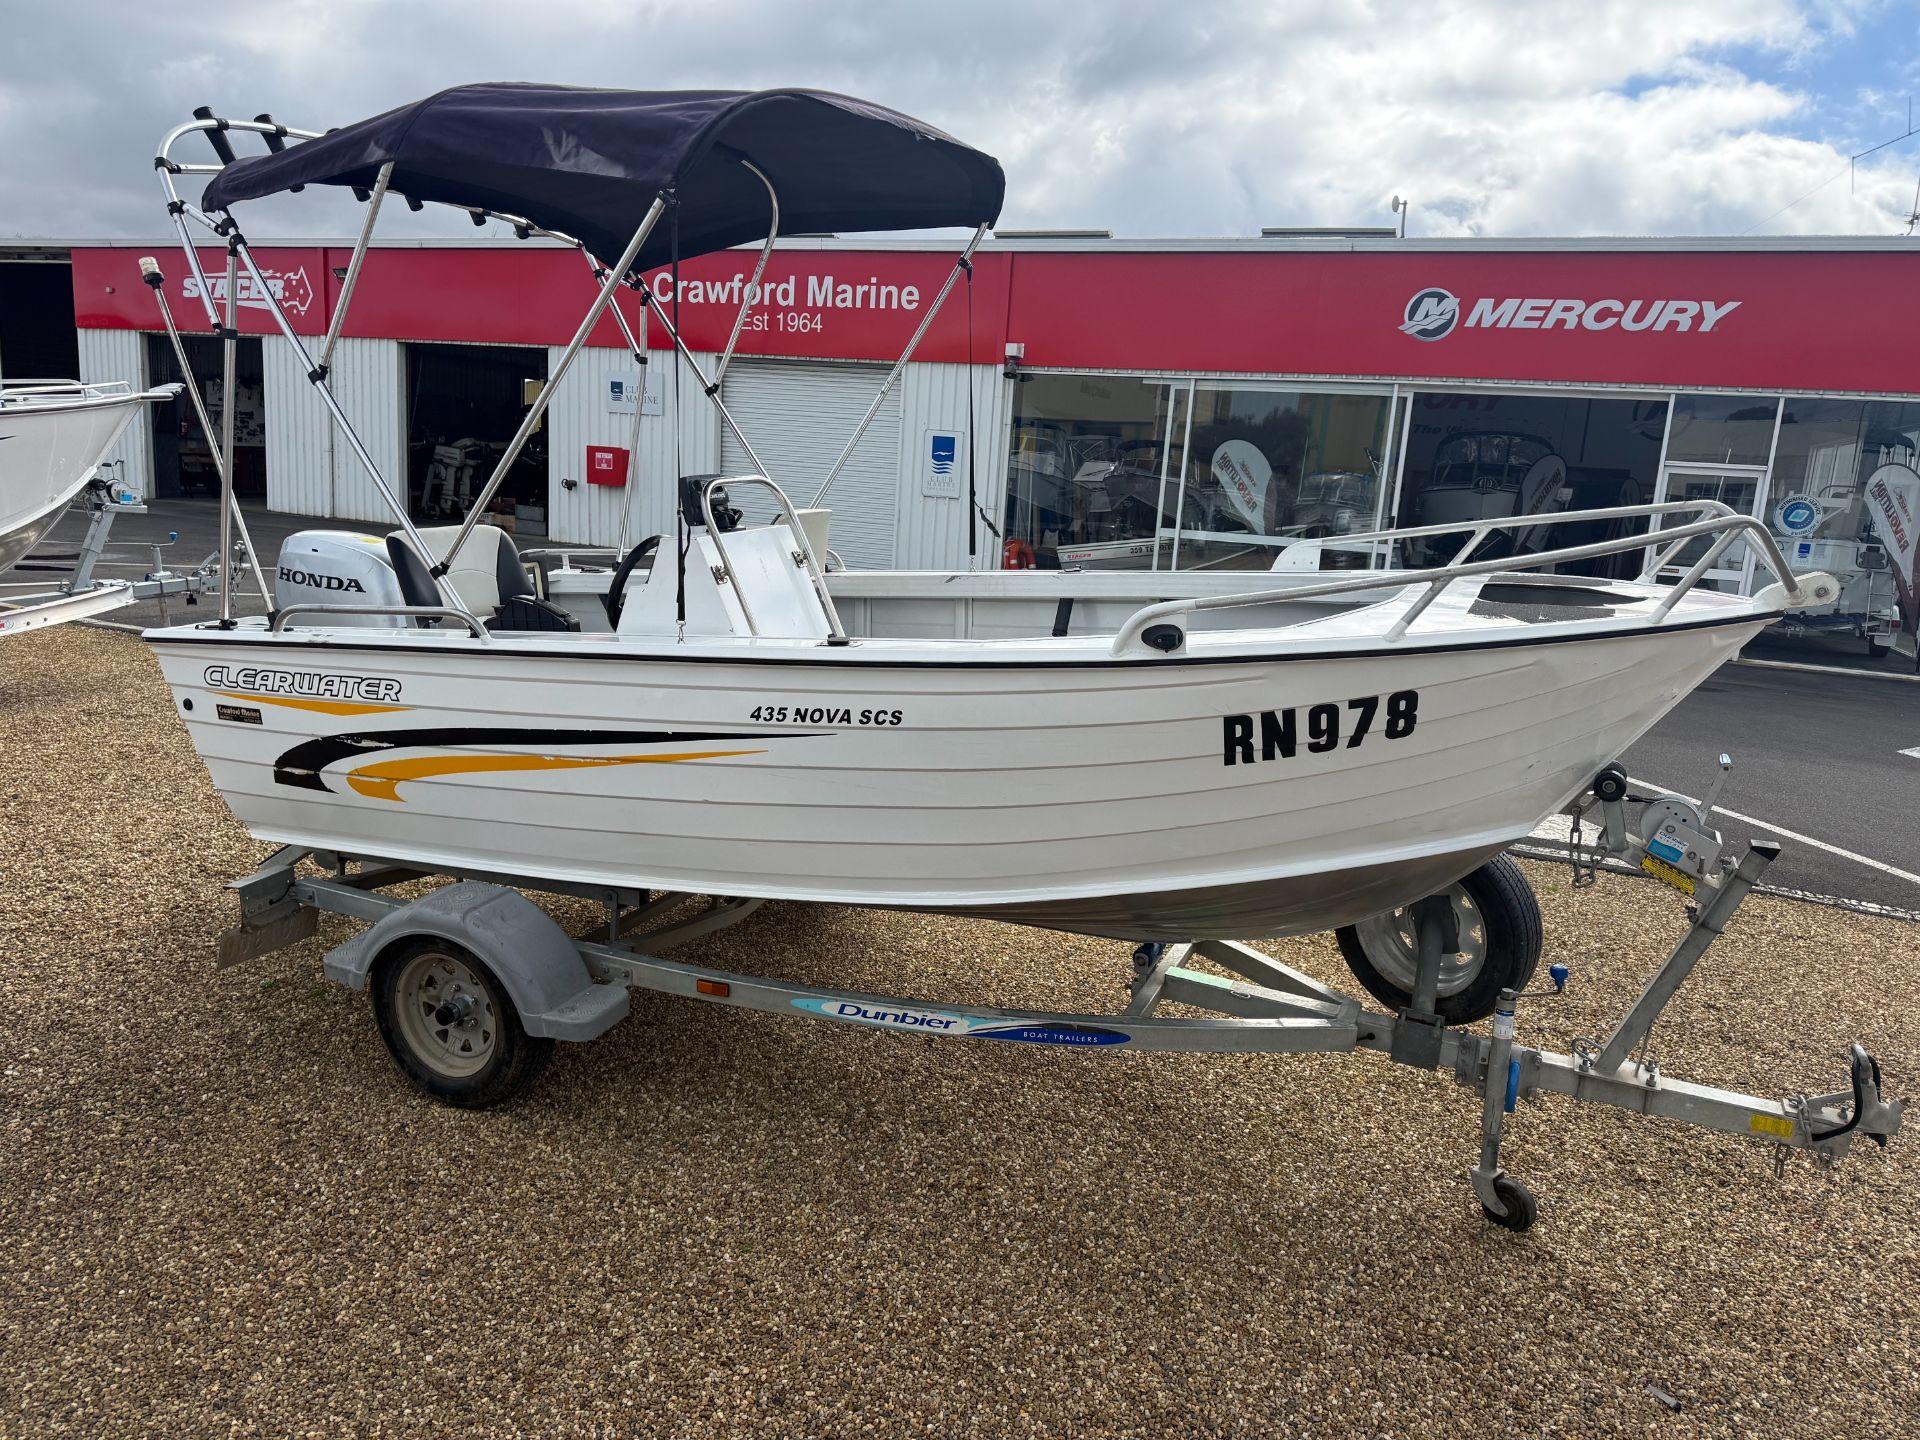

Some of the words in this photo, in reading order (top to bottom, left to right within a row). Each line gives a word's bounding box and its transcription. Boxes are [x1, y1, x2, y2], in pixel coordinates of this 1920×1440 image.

[183, 278, 285, 300] STACER
[652, 272, 796, 307] Crawford
[806, 275, 920, 310] Marine
[776, 312, 823, 333] 1964
[1464, 298, 1743, 332] MERCURY
[625, 395, 659, 405] MAINE
[279, 567, 367, 593] HONDA
[204, 665, 402, 702] CLEARWATER
[750, 706, 788, 723] 435
[793, 707, 852, 725] NOVA
[858, 709, 903, 726] SCS
[837, 1003, 957, 1029] Dunbier
[1023, 1032, 1048, 1040] BOAT
[1053, 1034, 1099, 1043] TRAILERS
